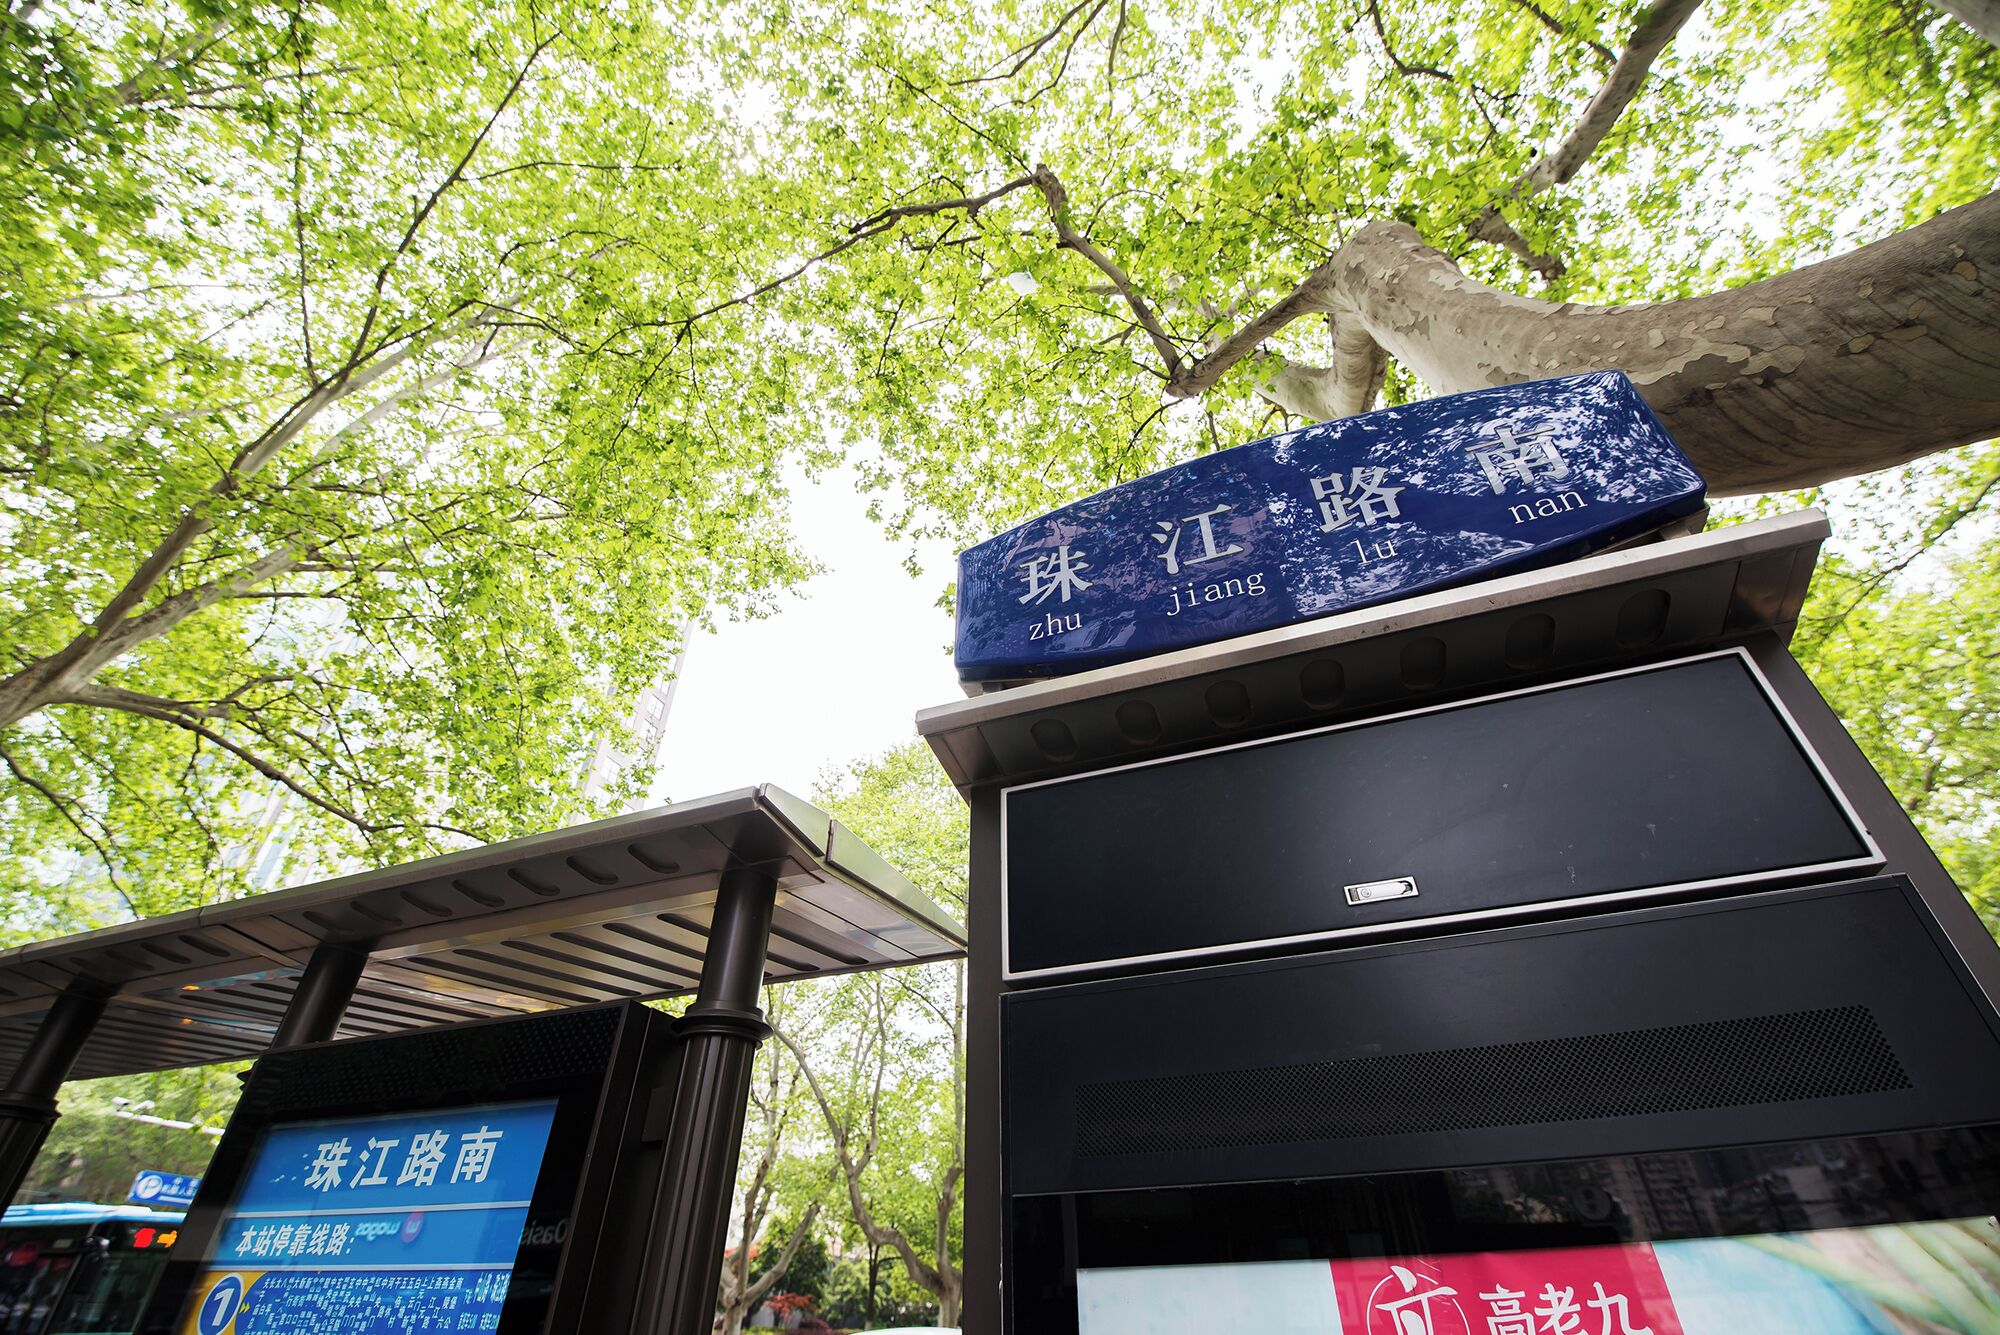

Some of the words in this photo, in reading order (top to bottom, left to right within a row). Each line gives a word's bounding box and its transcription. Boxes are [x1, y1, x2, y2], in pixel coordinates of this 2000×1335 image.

[1018, 425, 1572, 607] 珠江路南
[1030, 611, 1083, 642] zhu
[1166, 570, 1266, 616] jiang
[1355, 537, 1397, 565] lu
[1507, 488, 1585, 526] nan
[304, 1125, 503, 1192] 珠江路南
[210, 1288, 237, 1328] 1
